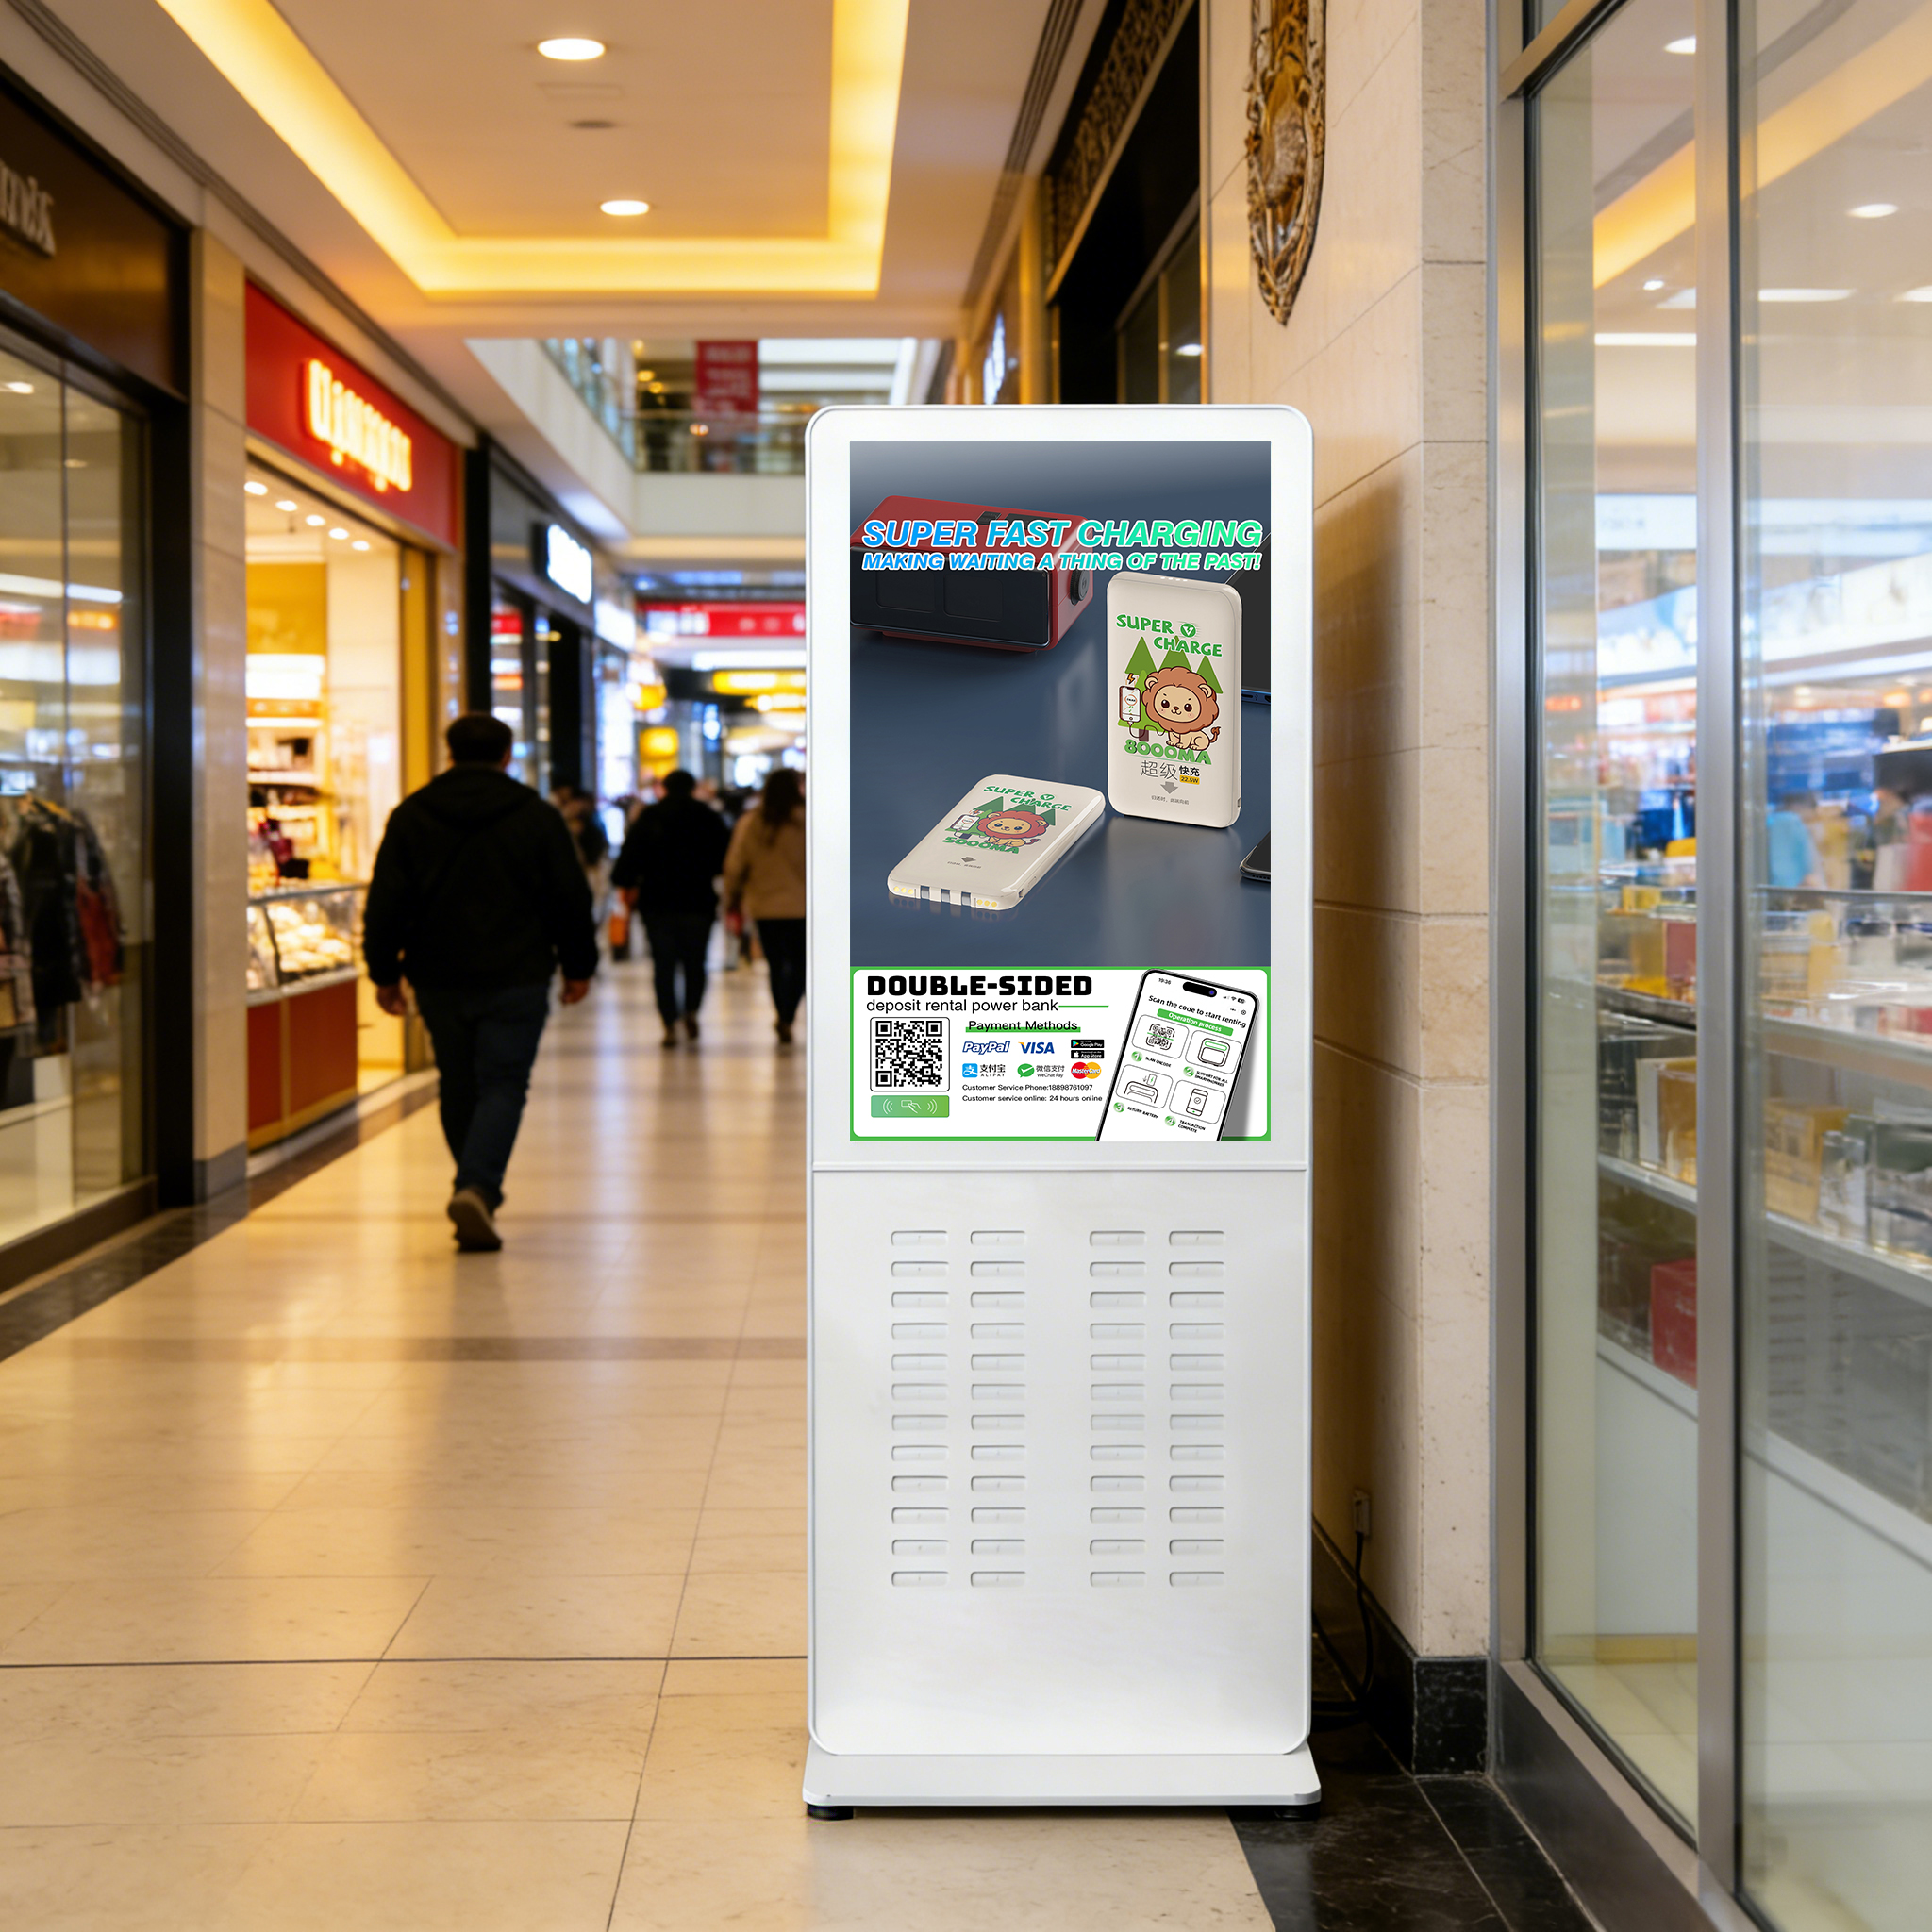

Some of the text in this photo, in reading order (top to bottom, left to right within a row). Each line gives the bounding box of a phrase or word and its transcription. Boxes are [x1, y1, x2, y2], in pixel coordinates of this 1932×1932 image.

[862, 520, 1262, 547] SUPER FAST CHARGING
[862, 552, 1262, 571] MAKING WAITING A THING OF THE PAST!
[1116, 614, 1174, 635] SUPER
[1153, 637, 1223, 658] CHARGE
[1124, 739, 1212, 765] 8000MA
[1141, 760, 1200, 781] 超级 快充
[1180, 775, 1199, 784] 22.5W
[983, 785, 1035, 799] SUPER
[1009, 797, 1072, 812] CHARGE
[941, 836, 1019, 854] 5000MA
[867, 975, 1092, 996] DOUBLE-SIDED
[866, 999, 1058, 1014] deposit rental power bank
[1148, 995, 1165, 1006] Scan
[1166, 1000, 1178, 1008] the
[1178, 1004, 1195, 1013] code
[1205, 1011, 1222, 1021] start
[1222, 1018, 1247, 1028] renting
[969, 1021, 1078, 1032] Payment Methods
[1168, 1012, 1222, 1032] Operation process
[962, 1041, 1010, 1055] PayPal
[1018, 1041, 1055, 1054] VISA
